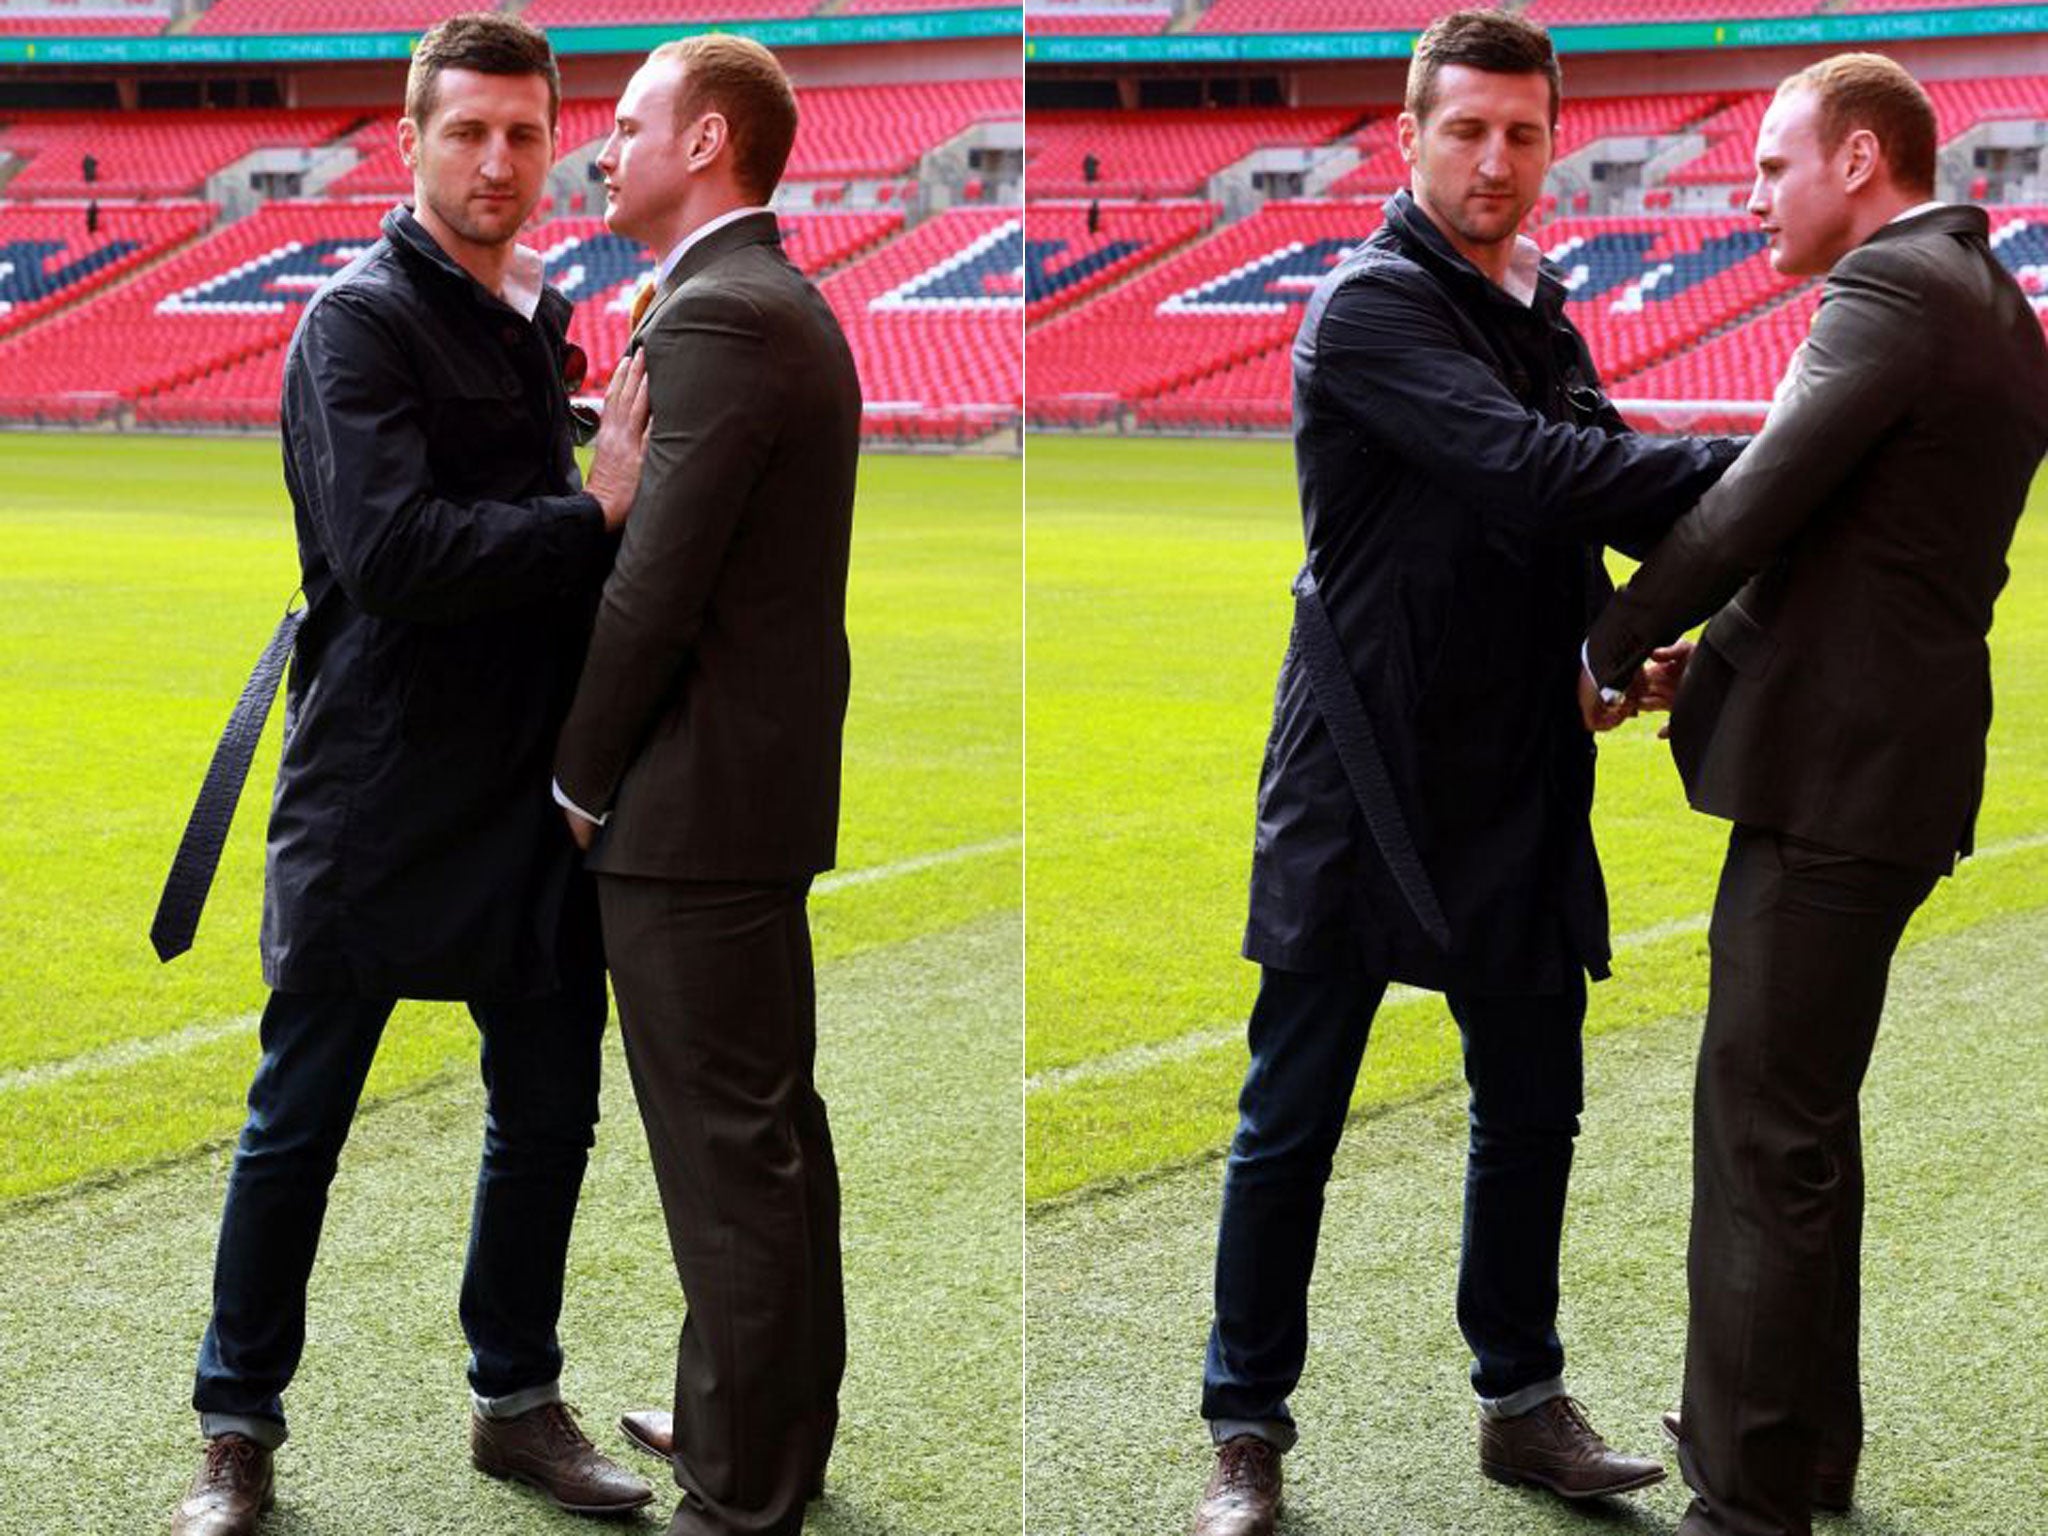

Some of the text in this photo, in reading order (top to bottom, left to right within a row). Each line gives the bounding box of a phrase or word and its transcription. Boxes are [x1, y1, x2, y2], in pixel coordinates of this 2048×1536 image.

[860, 17, 945, 36] WEMBLEY
[1738, 23, 1823, 43] WELCOME
[1833, 20, 1859, 38] TO
[1865, 16, 1950, 36] WEMBLEY
[49, 38, 398, 58] WELCOME TO WEMBLEY CONNECTED BY
[1049, 37, 1400, 58] WELCOME TO WEMBLEY CONNECTED BY
